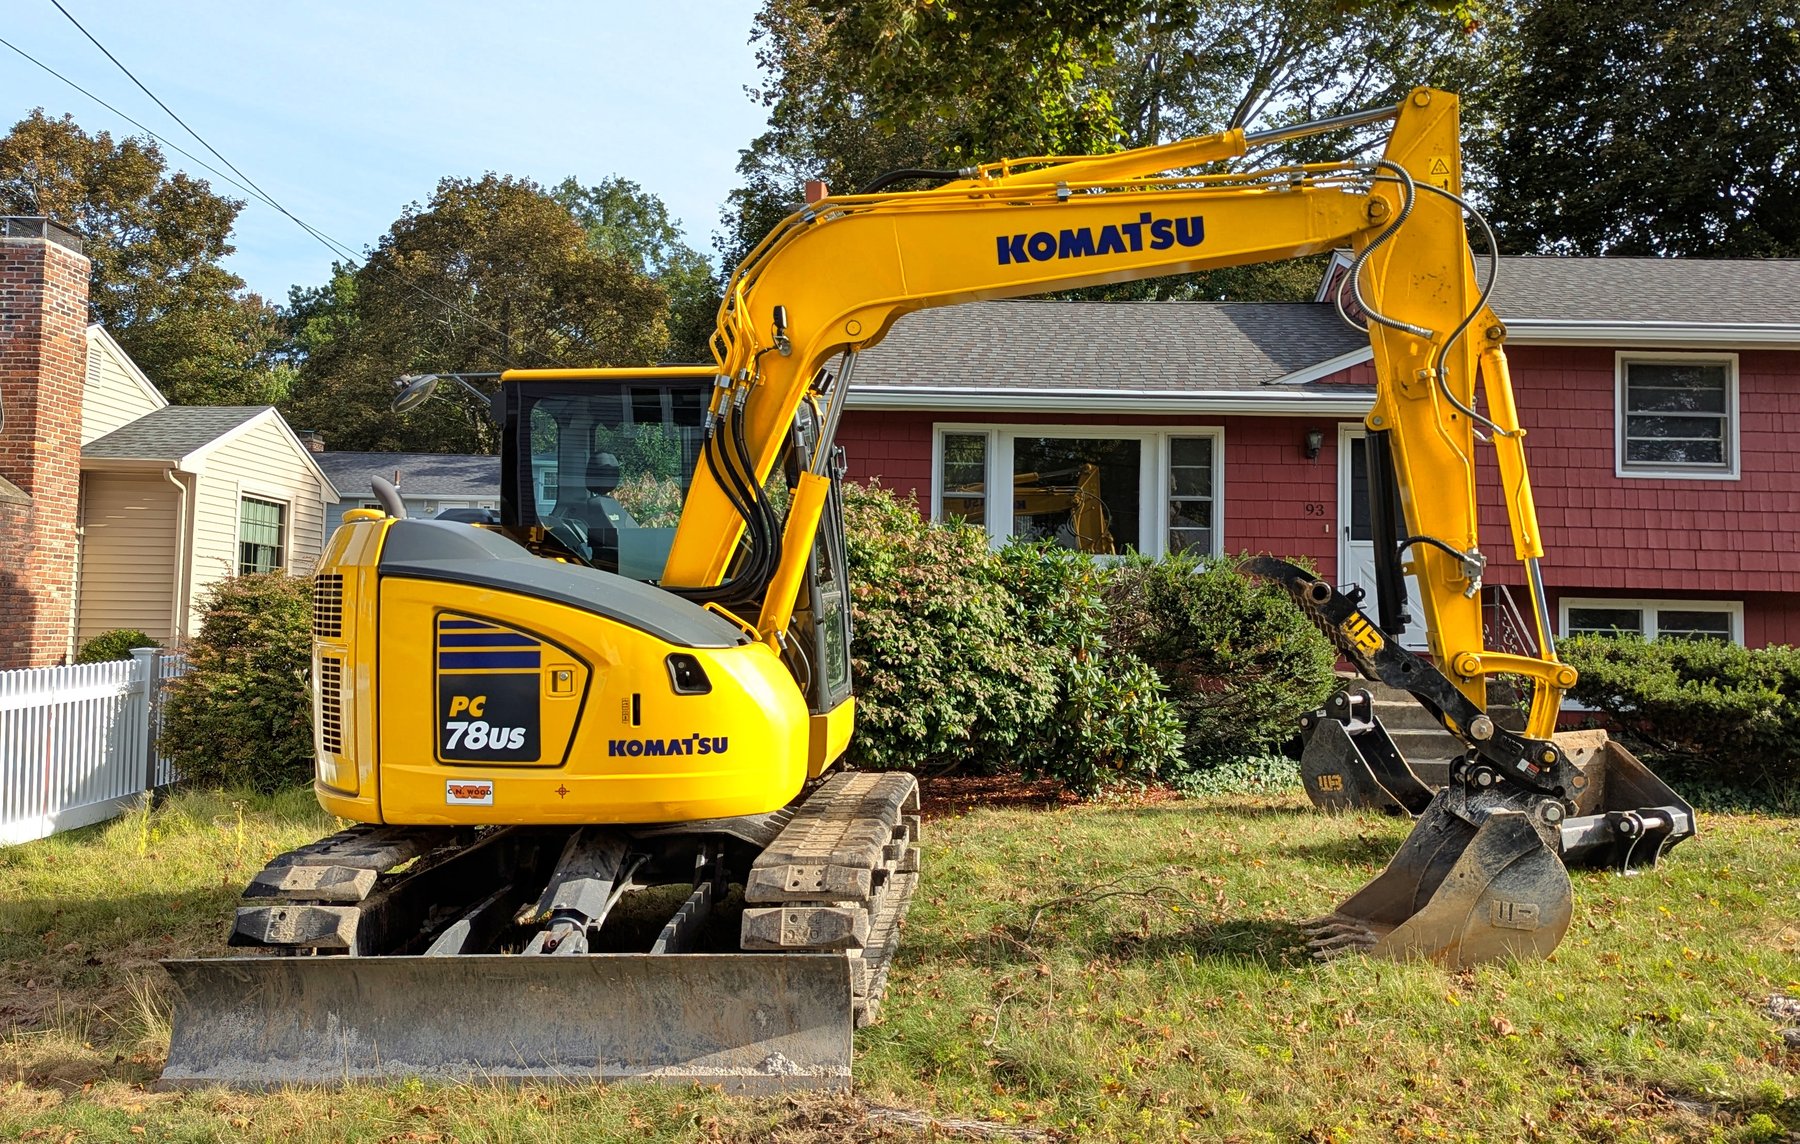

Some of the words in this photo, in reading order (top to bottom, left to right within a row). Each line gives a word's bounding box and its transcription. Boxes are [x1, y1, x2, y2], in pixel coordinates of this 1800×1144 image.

[996, 212, 1205, 265] KOMATSU
[1305, 503, 1325, 517] 93
[449, 695, 487, 717] PC
[446, 721, 526, 750] 78US
[608, 733, 728, 757] KOMATSU
